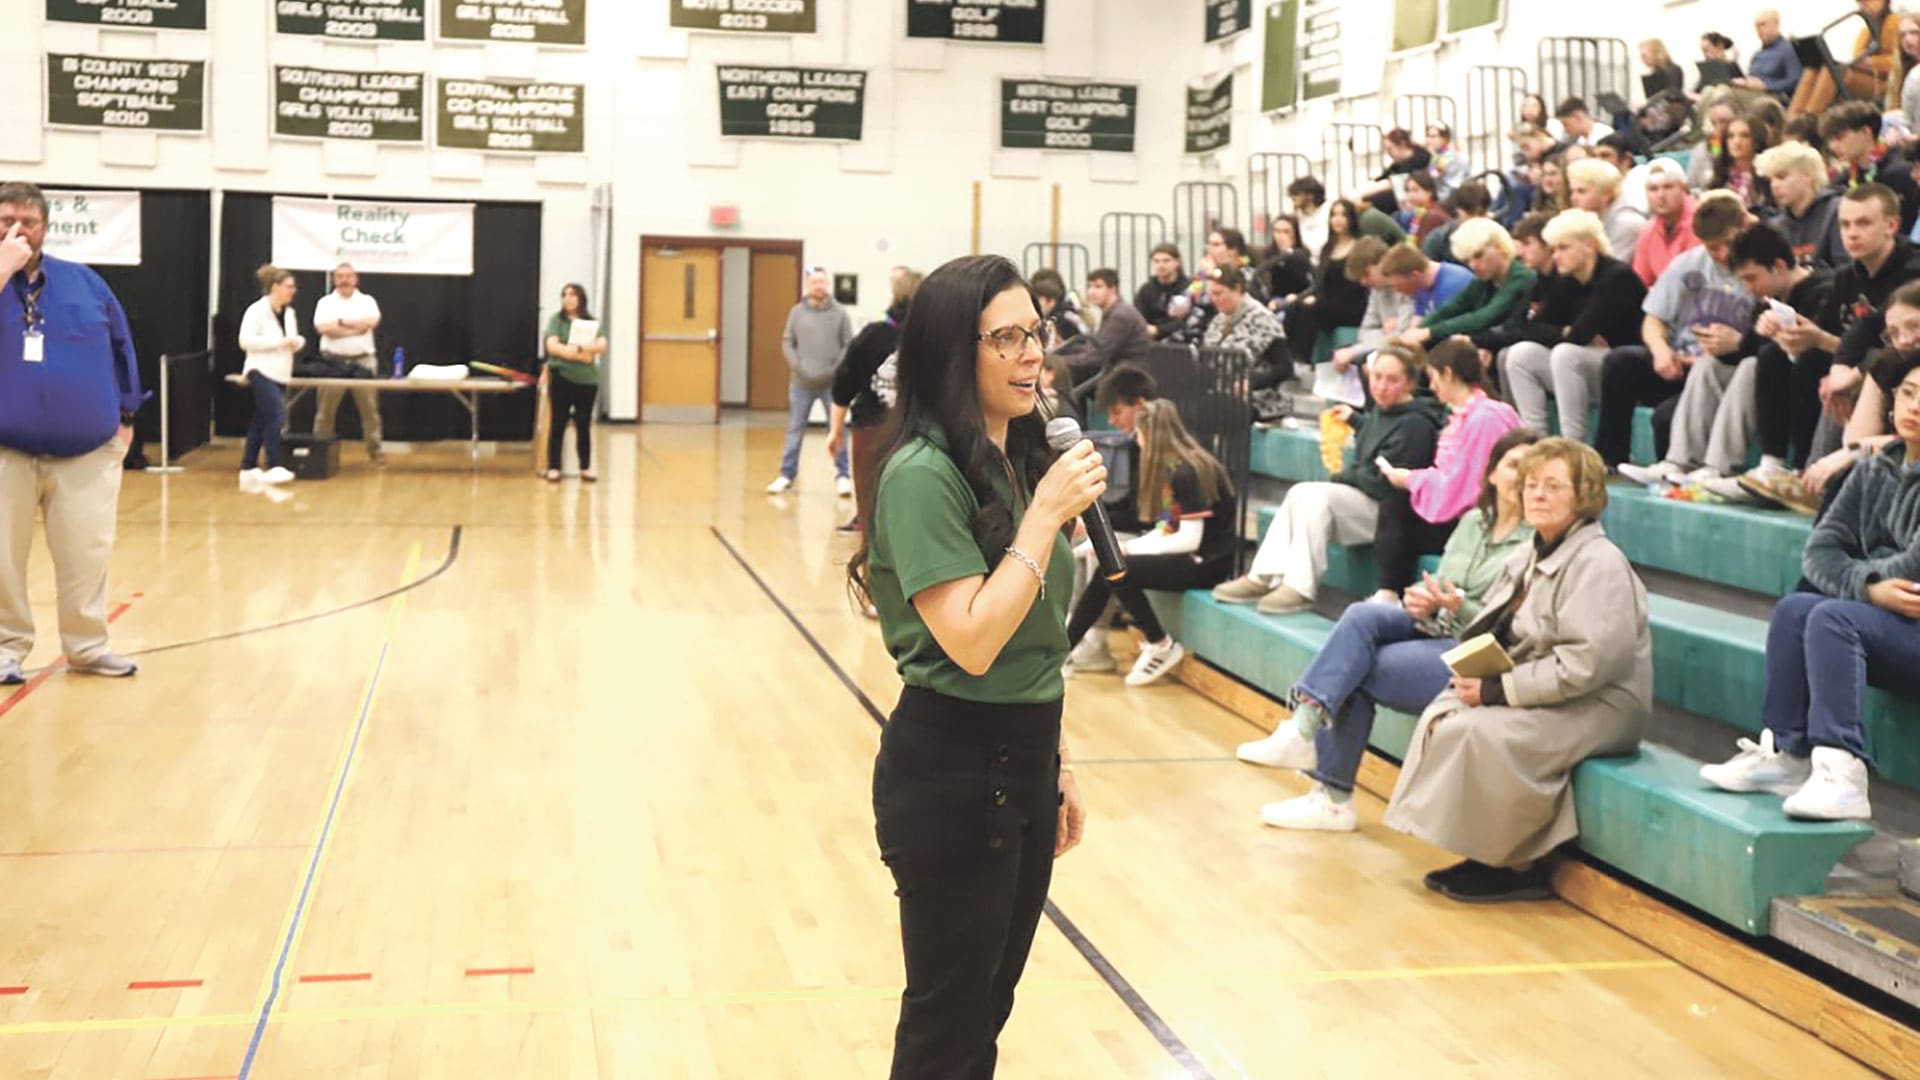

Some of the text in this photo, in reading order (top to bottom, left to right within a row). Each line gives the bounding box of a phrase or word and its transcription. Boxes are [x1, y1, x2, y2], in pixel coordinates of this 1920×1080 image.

[277, 1, 422, 22] GIRLS VOLLEYBALL
[455, 4, 492, 20] GIRLS
[494, 7, 570, 25] VOLLEYBALL
[732, 0, 804, 13] SOCCER
[951, 7, 999, 22] GOLF
[719, 14, 768, 29] 2013
[147, 63, 190, 78] WEST
[279, 68, 419, 90] SOUTHERN LEAGUE
[719, 68, 863, 87] NORTHERN LEAGUE
[73, 75, 179, 94] CHAMPIONS
[445, 82, 577, 100] CENTRAL LEAGUE
[1016, 83, 1121, 101] NORTHERN LEAGUE
[77, 91, 176, 111] SOFTBALL
[299, 87, 400, 106] CHAMPIONS
[726, 85, 857, 103] EAST CHAMPIONS
[278, 101, 420, 122] GIRLS VOLLEYBALL
[446, 97, 575, 117] CO-CHAMPIONS
[766, 103, 817, 117] GOLF
[1009, 99, 1128, 117] EAST CHAMPIONS
[102, 110, 149, 126] 2010
[453, 114, 568, 133] GIRLS VOLLEYBALL
[1045, 116, 1091, 131] GOLF
[327, 121, 374, 137] 2010
[1045, 132, 1092, 147] 2000
[73, 195, 88, 213] &
[336, 205, 410, 226] Reality
[341, 227, 405, 244] Check
